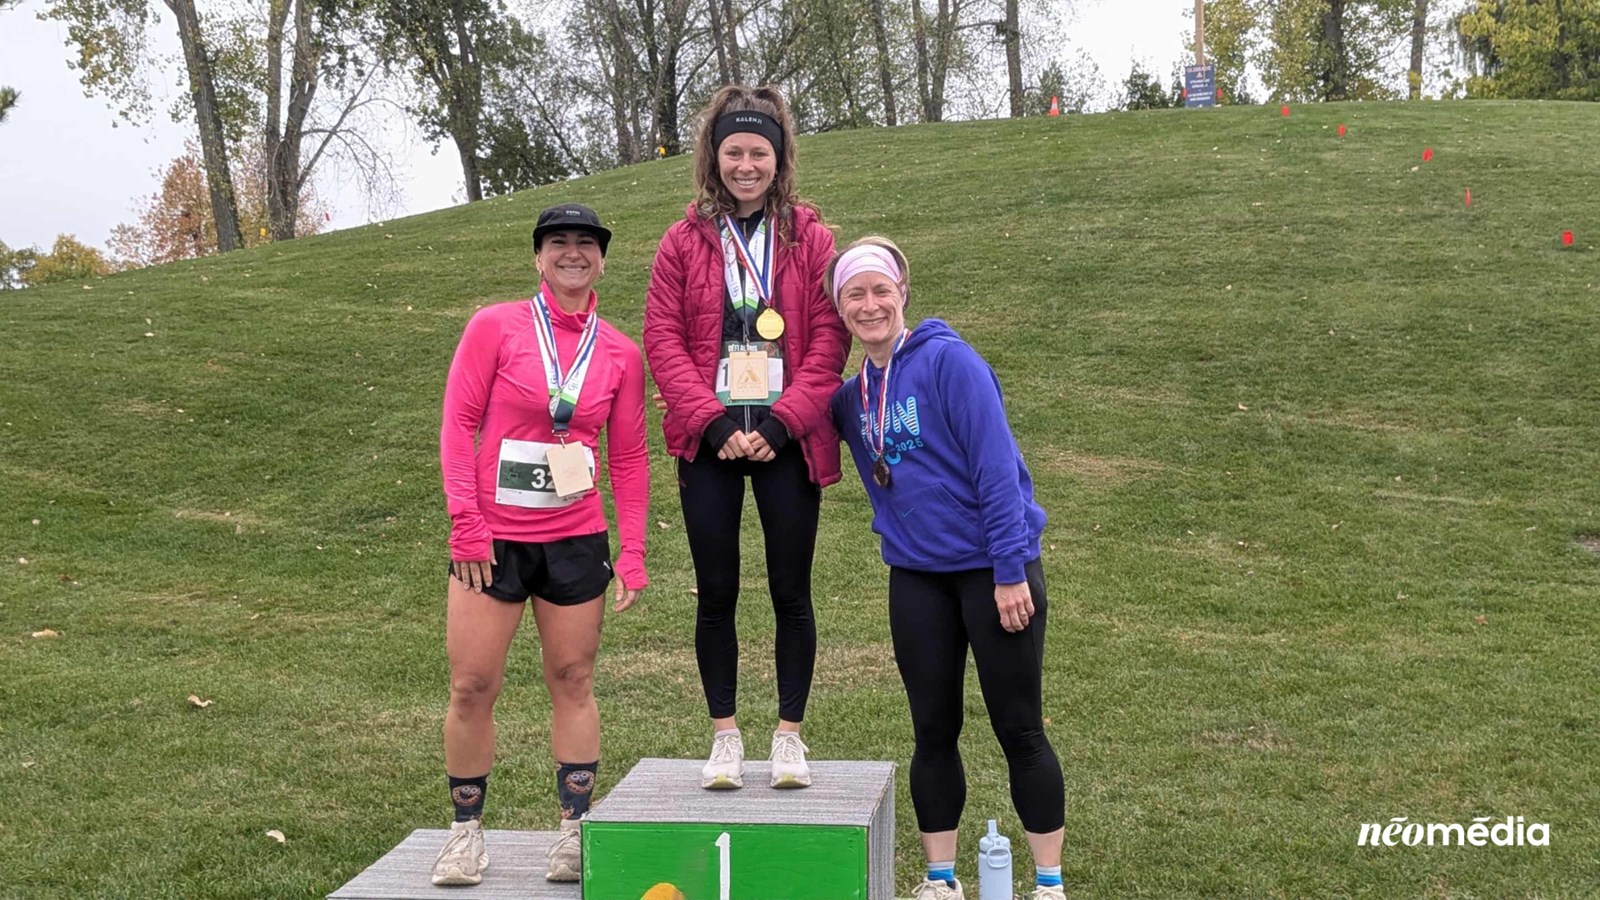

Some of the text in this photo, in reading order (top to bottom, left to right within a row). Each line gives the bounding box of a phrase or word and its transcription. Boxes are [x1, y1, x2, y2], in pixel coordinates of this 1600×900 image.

[736, 116, 762, 124] KALENJI
[895, 437, 923, 451] 2025
[715, 832, 731, 900] 1
